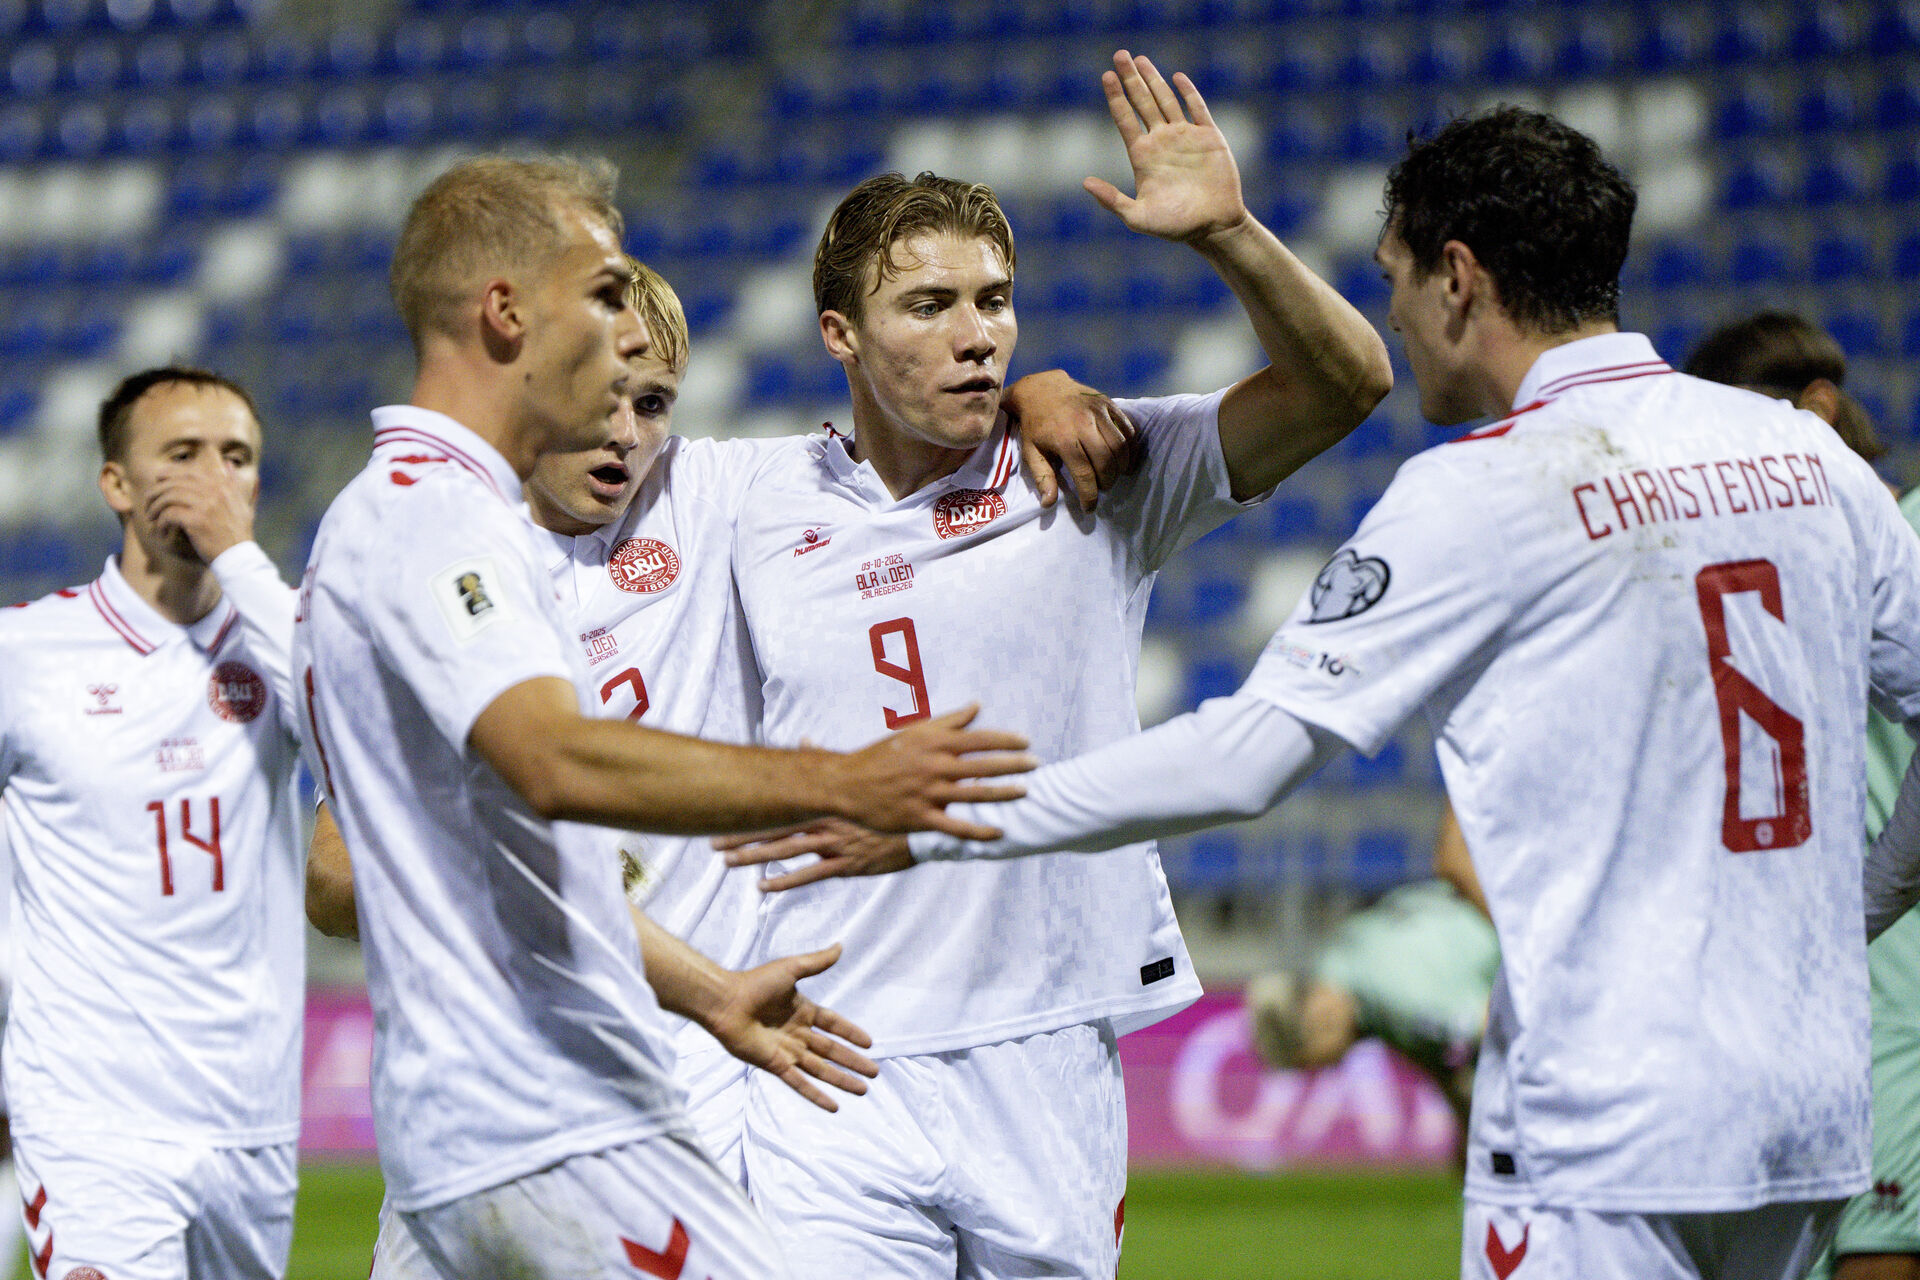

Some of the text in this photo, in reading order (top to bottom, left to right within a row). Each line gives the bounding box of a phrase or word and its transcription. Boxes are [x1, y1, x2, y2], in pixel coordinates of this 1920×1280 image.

[1572, 453, 1833, 541] CHRISTENSEN
[949, 504, 993, 528] DBU
[793, 536, 832, 558] hummel
[621, 551, 667, 582] DBU
[861, 553, 904, 571] 09-10-2025
[644, 576, 671, 592] 1889
[855, 571, 880, 591] BLR
[888, 563, 915, 583] DEN
[591, 633, 618, 655] DEN
[868, 616, 932, 731] 9
[1695, 558, 1813, 853] 6
[146, 796, 224, 897] 14
